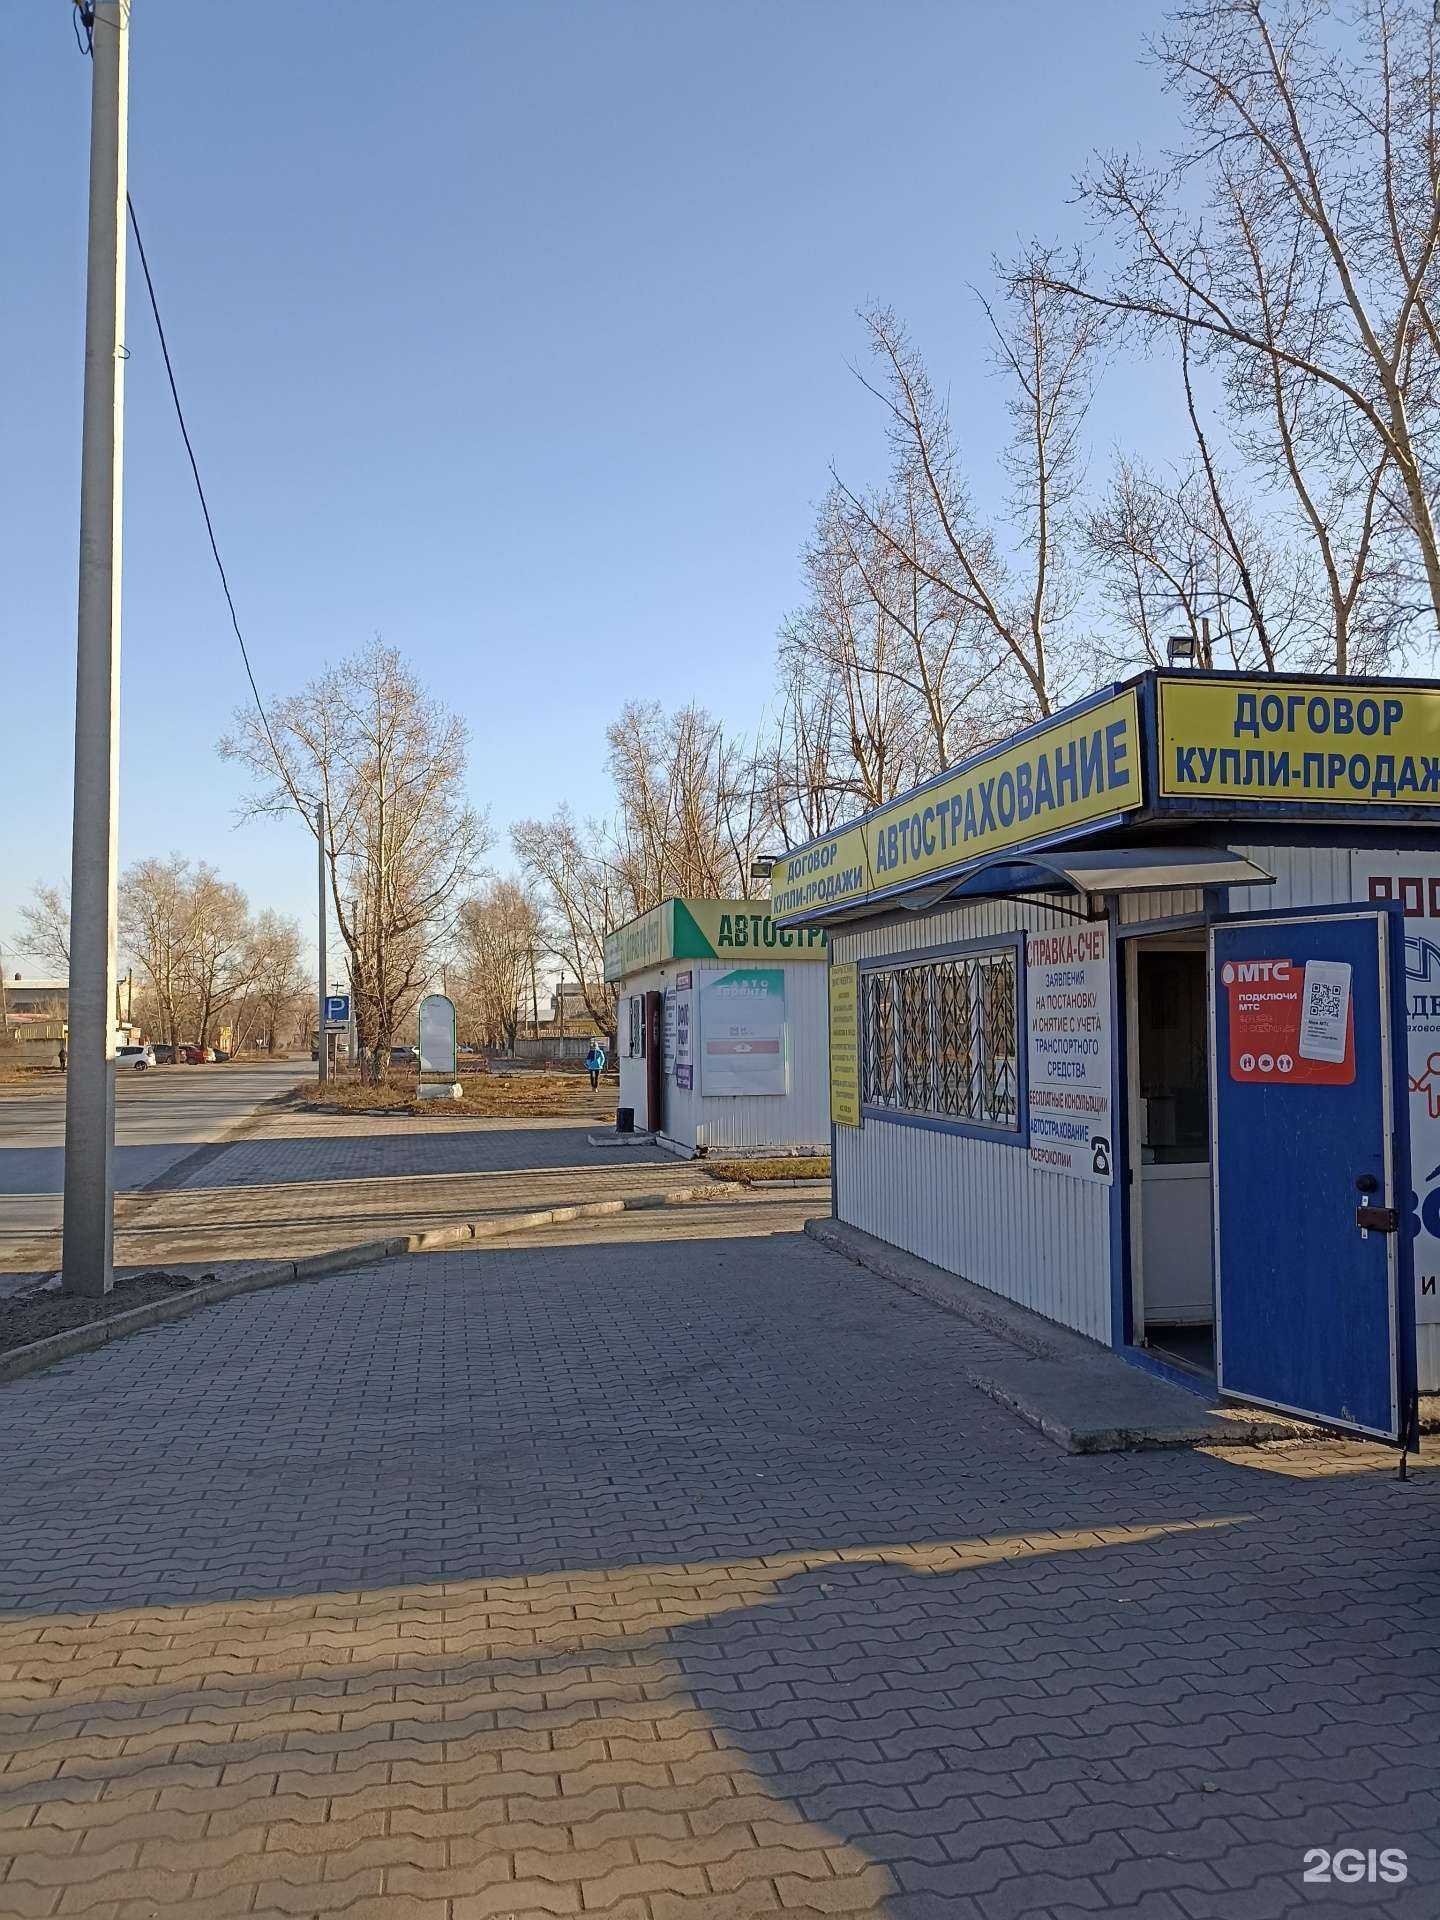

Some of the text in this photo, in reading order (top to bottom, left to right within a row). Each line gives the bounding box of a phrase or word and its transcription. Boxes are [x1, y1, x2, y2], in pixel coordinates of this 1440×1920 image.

[1234, 692, 1404, 738] ДОГОВОР
[1176, 746, 1440, 798] КУПЛИ-ПРОДАЖ
[876, 718, 1130, 874] АВТОСТРАХОВАНИЕ
[787, 843, 837, 882] ДОГОВОР
[773, 865, 863, 914] КУПЛИ-ПРОДАЖИ
[1027, 932, 1106, 967] СПРАВКА-СЧЕТ
[1045, 971, 1085, 987] ЗАЯВЛЕНИЯ
[1238, 962, 1290, 982] МТС
[328, 998, 345, 1018] P
[1036, 992, 1097, 1010] НА ПОСТАНОВКУ
[1032, 1015, 1101, 1033] И СНЯТИЕ С УЧЕТА
[1035, 1038, 1099, 1055] ТРАНСПОРТНОГО
[1047, 1061, 1086, 1079] СРЕДСТВА
[1029, 1090, 1108, 1114] БЕСПЛАТНЫЕ КОНСУЛЬТАЦИИ
[1030, 1118, 1089, 1142] АВТОСТРАХОВАНИЕ
